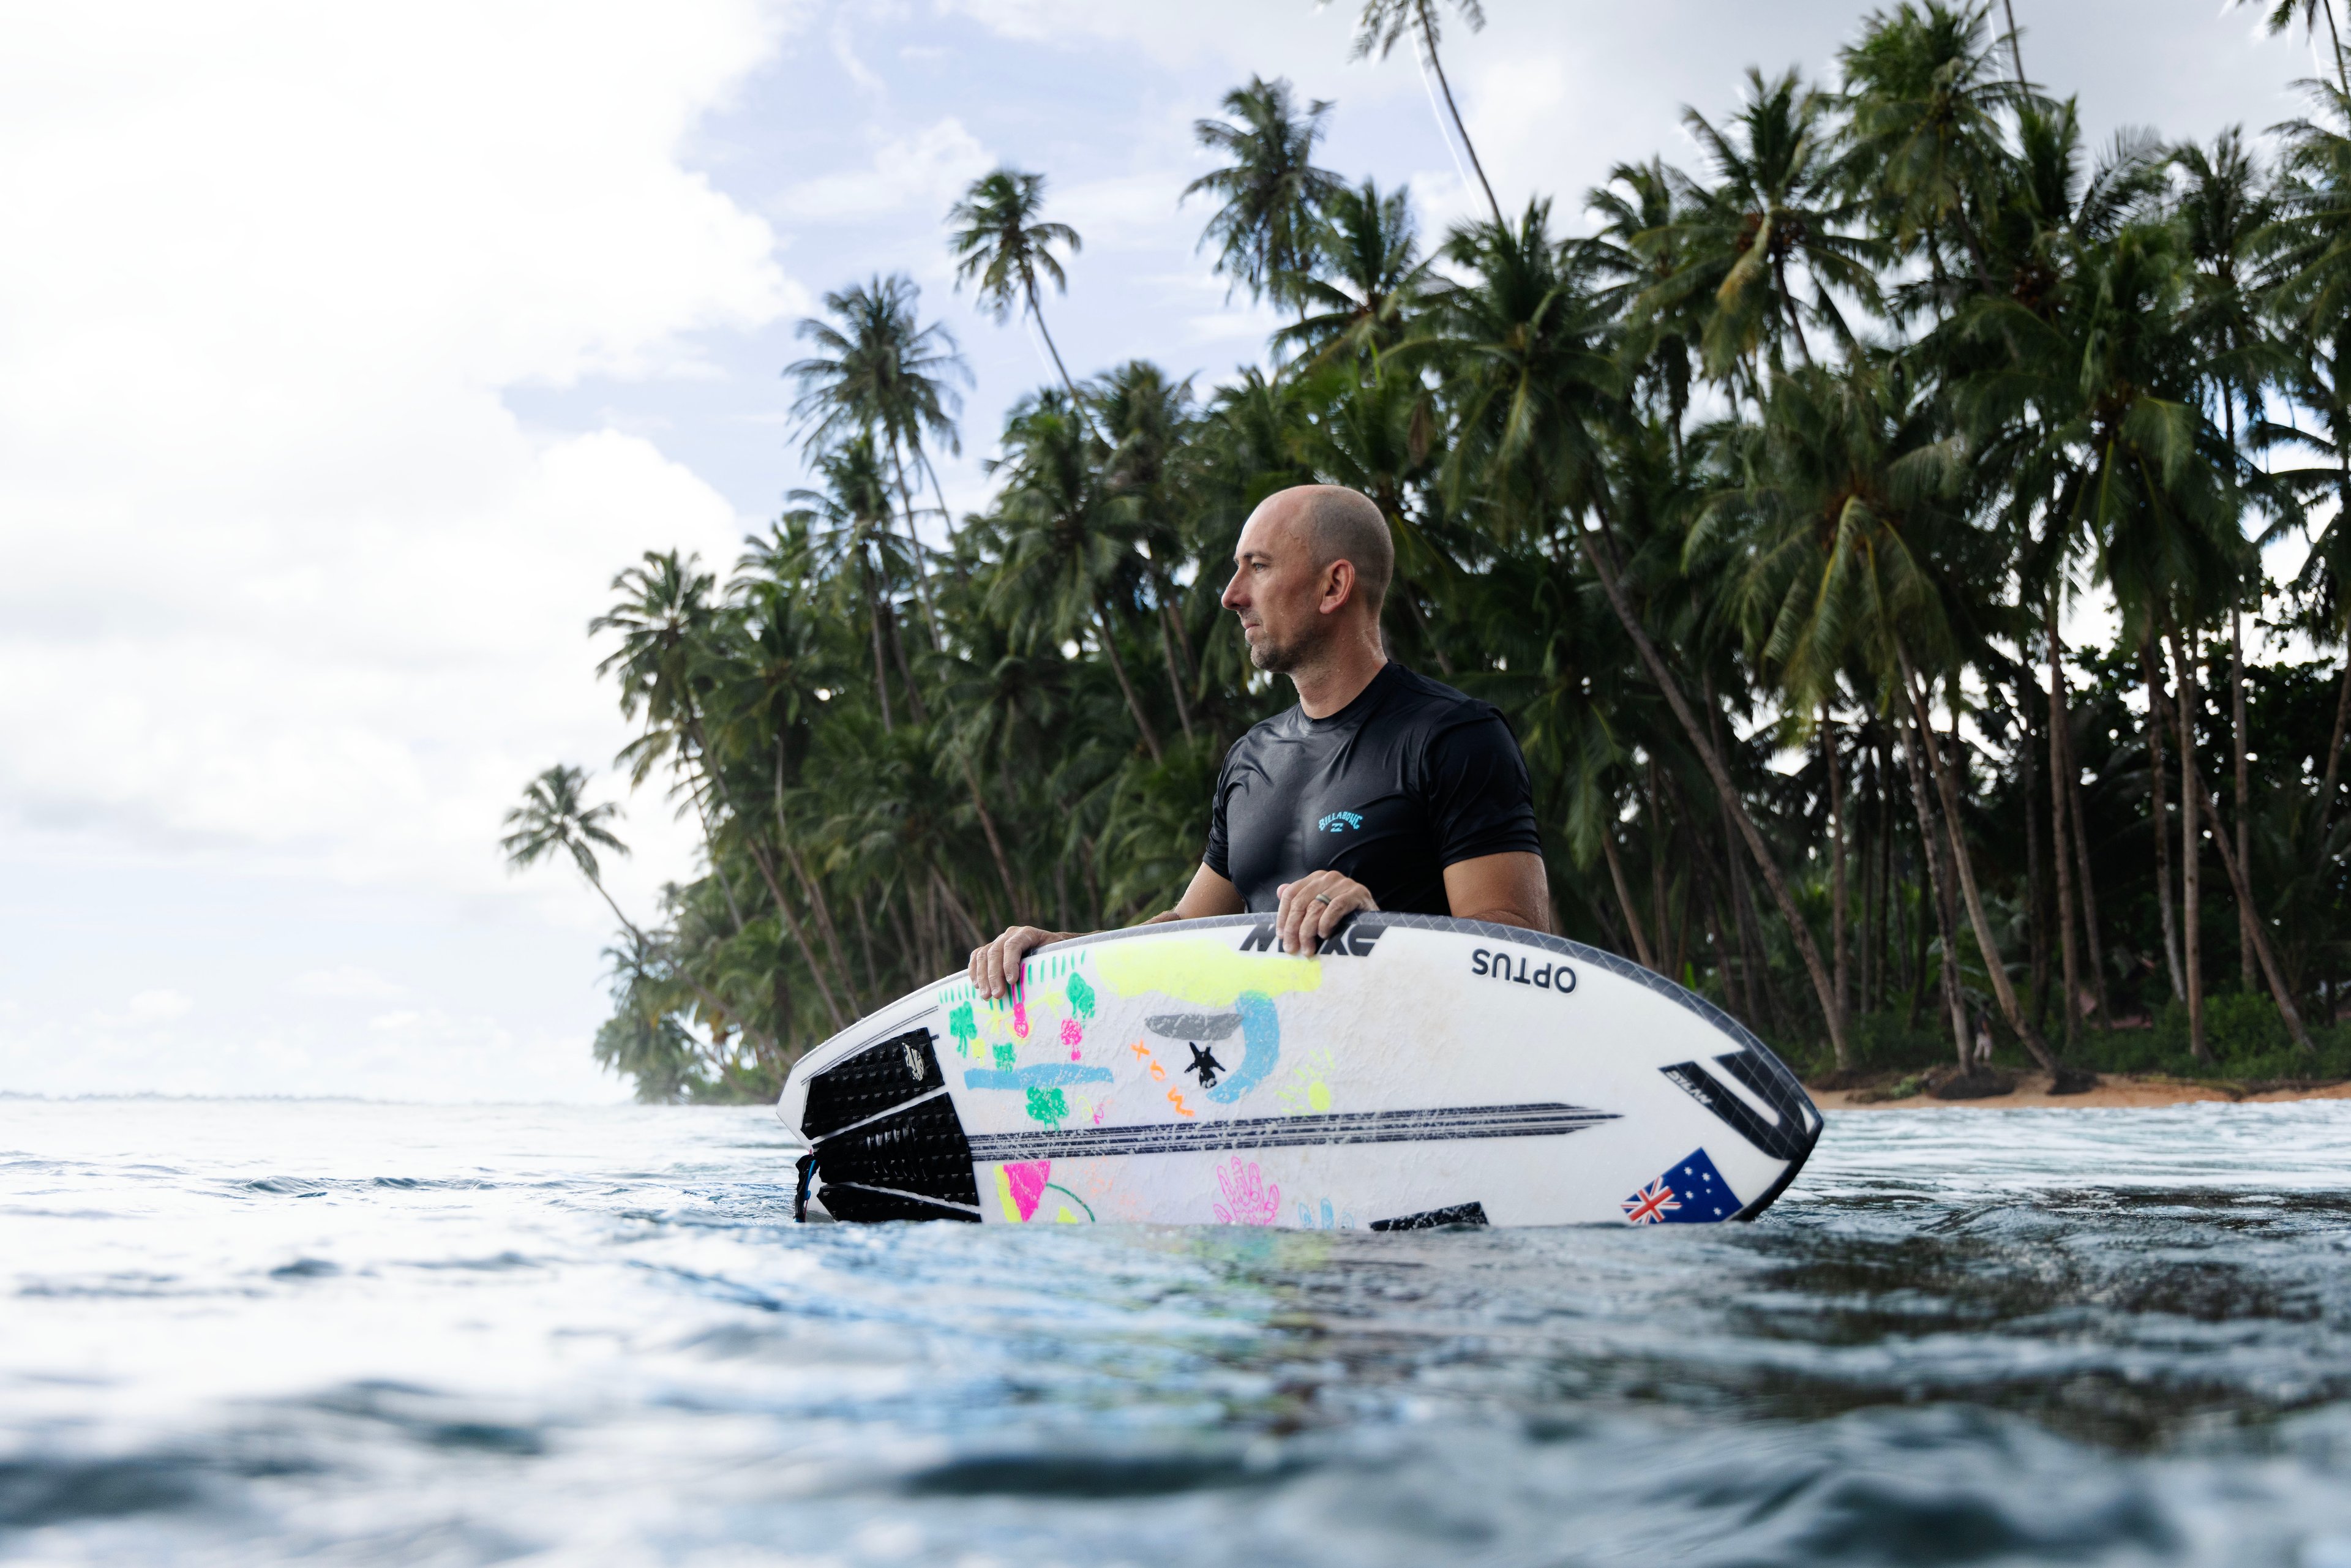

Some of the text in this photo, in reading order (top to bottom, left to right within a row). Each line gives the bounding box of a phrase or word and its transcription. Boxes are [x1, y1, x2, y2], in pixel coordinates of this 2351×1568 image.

[1318, 811, 1363, 831] BILLABONG
[1239, 922, 1389, 957] DYN
[1471, 948, 1577, 994] OPTUS
[1665, 1070, 1714, 1104] DYLAN
